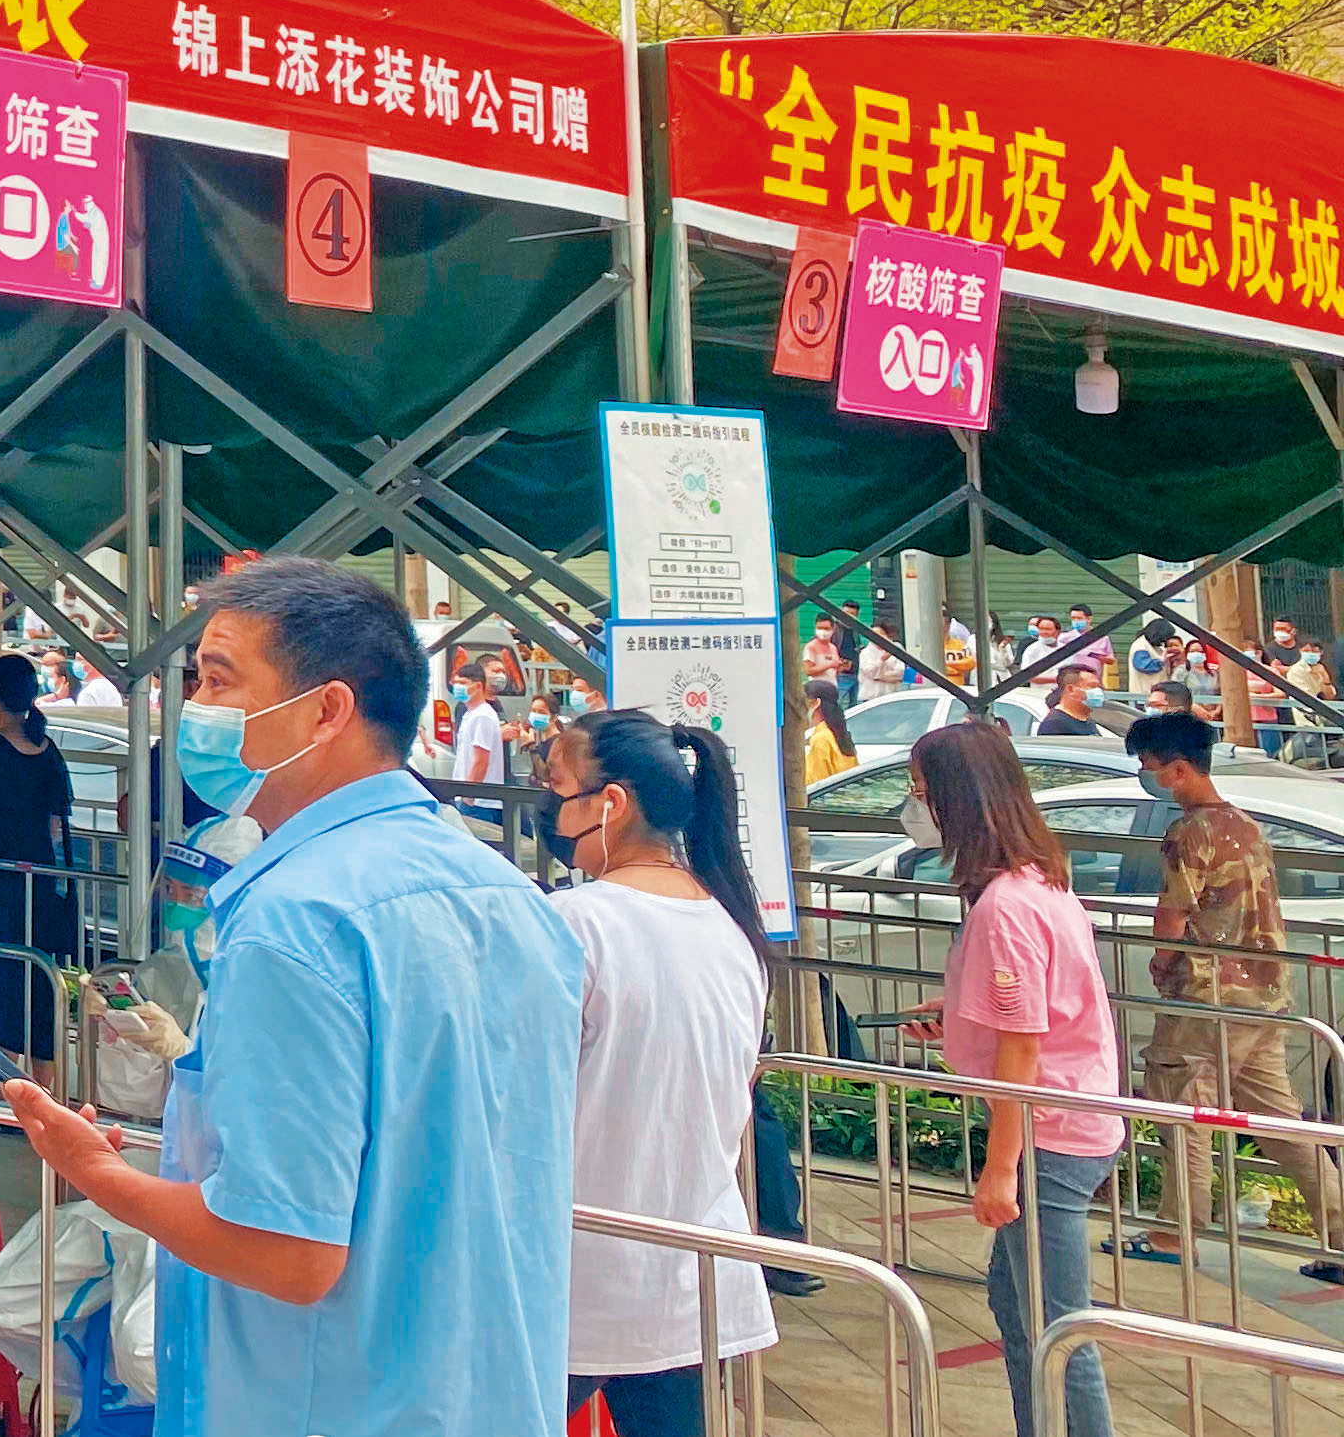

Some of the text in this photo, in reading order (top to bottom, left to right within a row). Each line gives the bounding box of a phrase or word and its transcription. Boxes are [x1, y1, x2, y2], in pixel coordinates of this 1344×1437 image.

[170, 0, 590, 154] 锦上添花装饰公司赠
[1090, 146, 1344, 316] 众志成城
[865, 255, 986, 325] 核酸筛查
[883, 332, 947, 384] 入口
[620, 420, 752, 442] 全员核酸检测二维码指引流程
[626, 634, 763, 652] 全员核酸检测二维码指引流程
